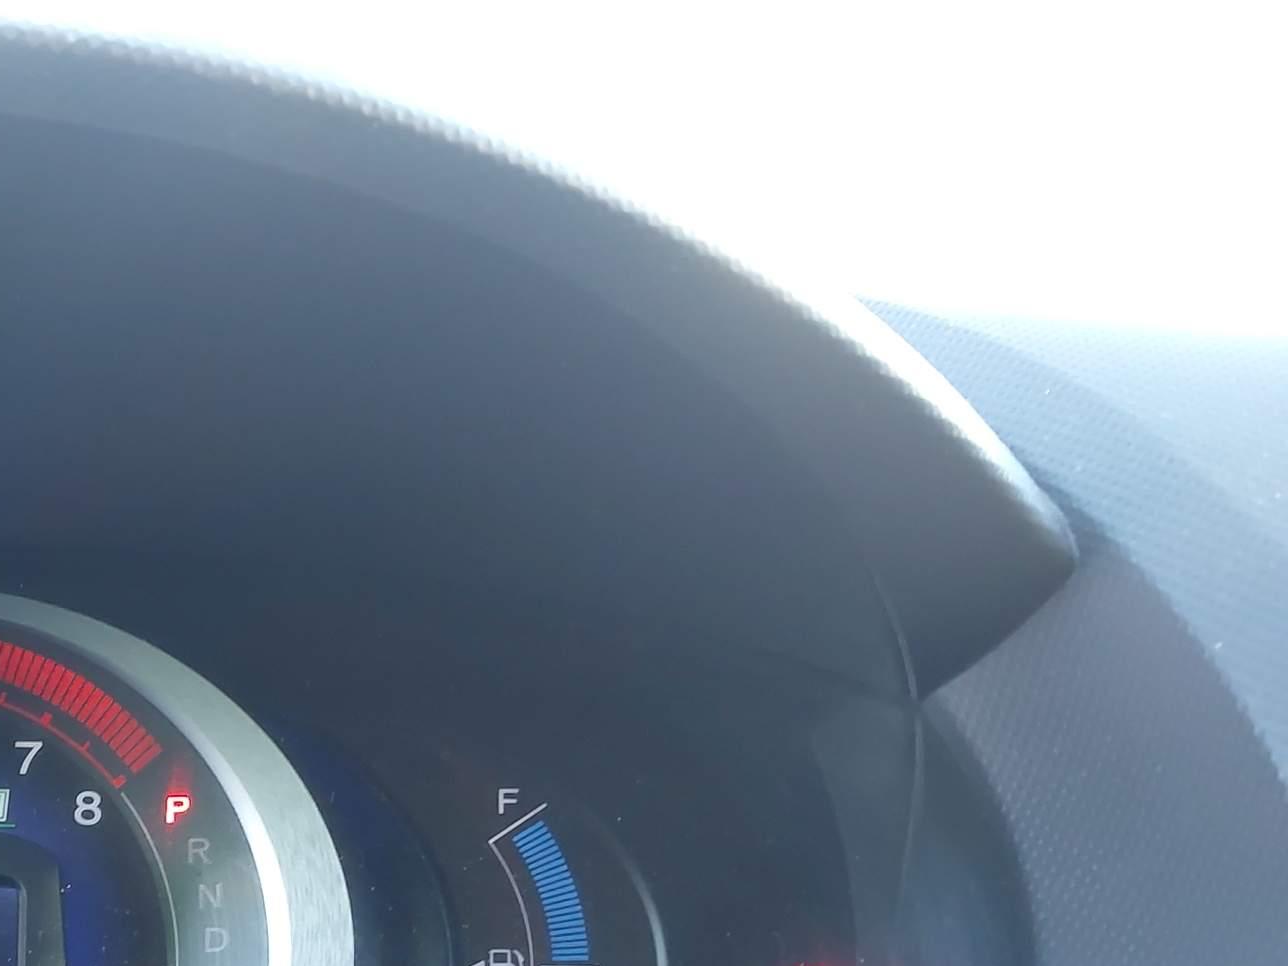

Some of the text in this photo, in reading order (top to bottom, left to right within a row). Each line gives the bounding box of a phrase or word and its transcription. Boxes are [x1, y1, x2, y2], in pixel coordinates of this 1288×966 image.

[14, 741, 43, 775] 7
[74, 791, 102, 826] 8
[165, 795, 191, 824] P
[498, 789, 519, 814] F
[187, 838, 211, 864] R
[198, 883, 223, 909] N
[204, 927, 229, 952] D
